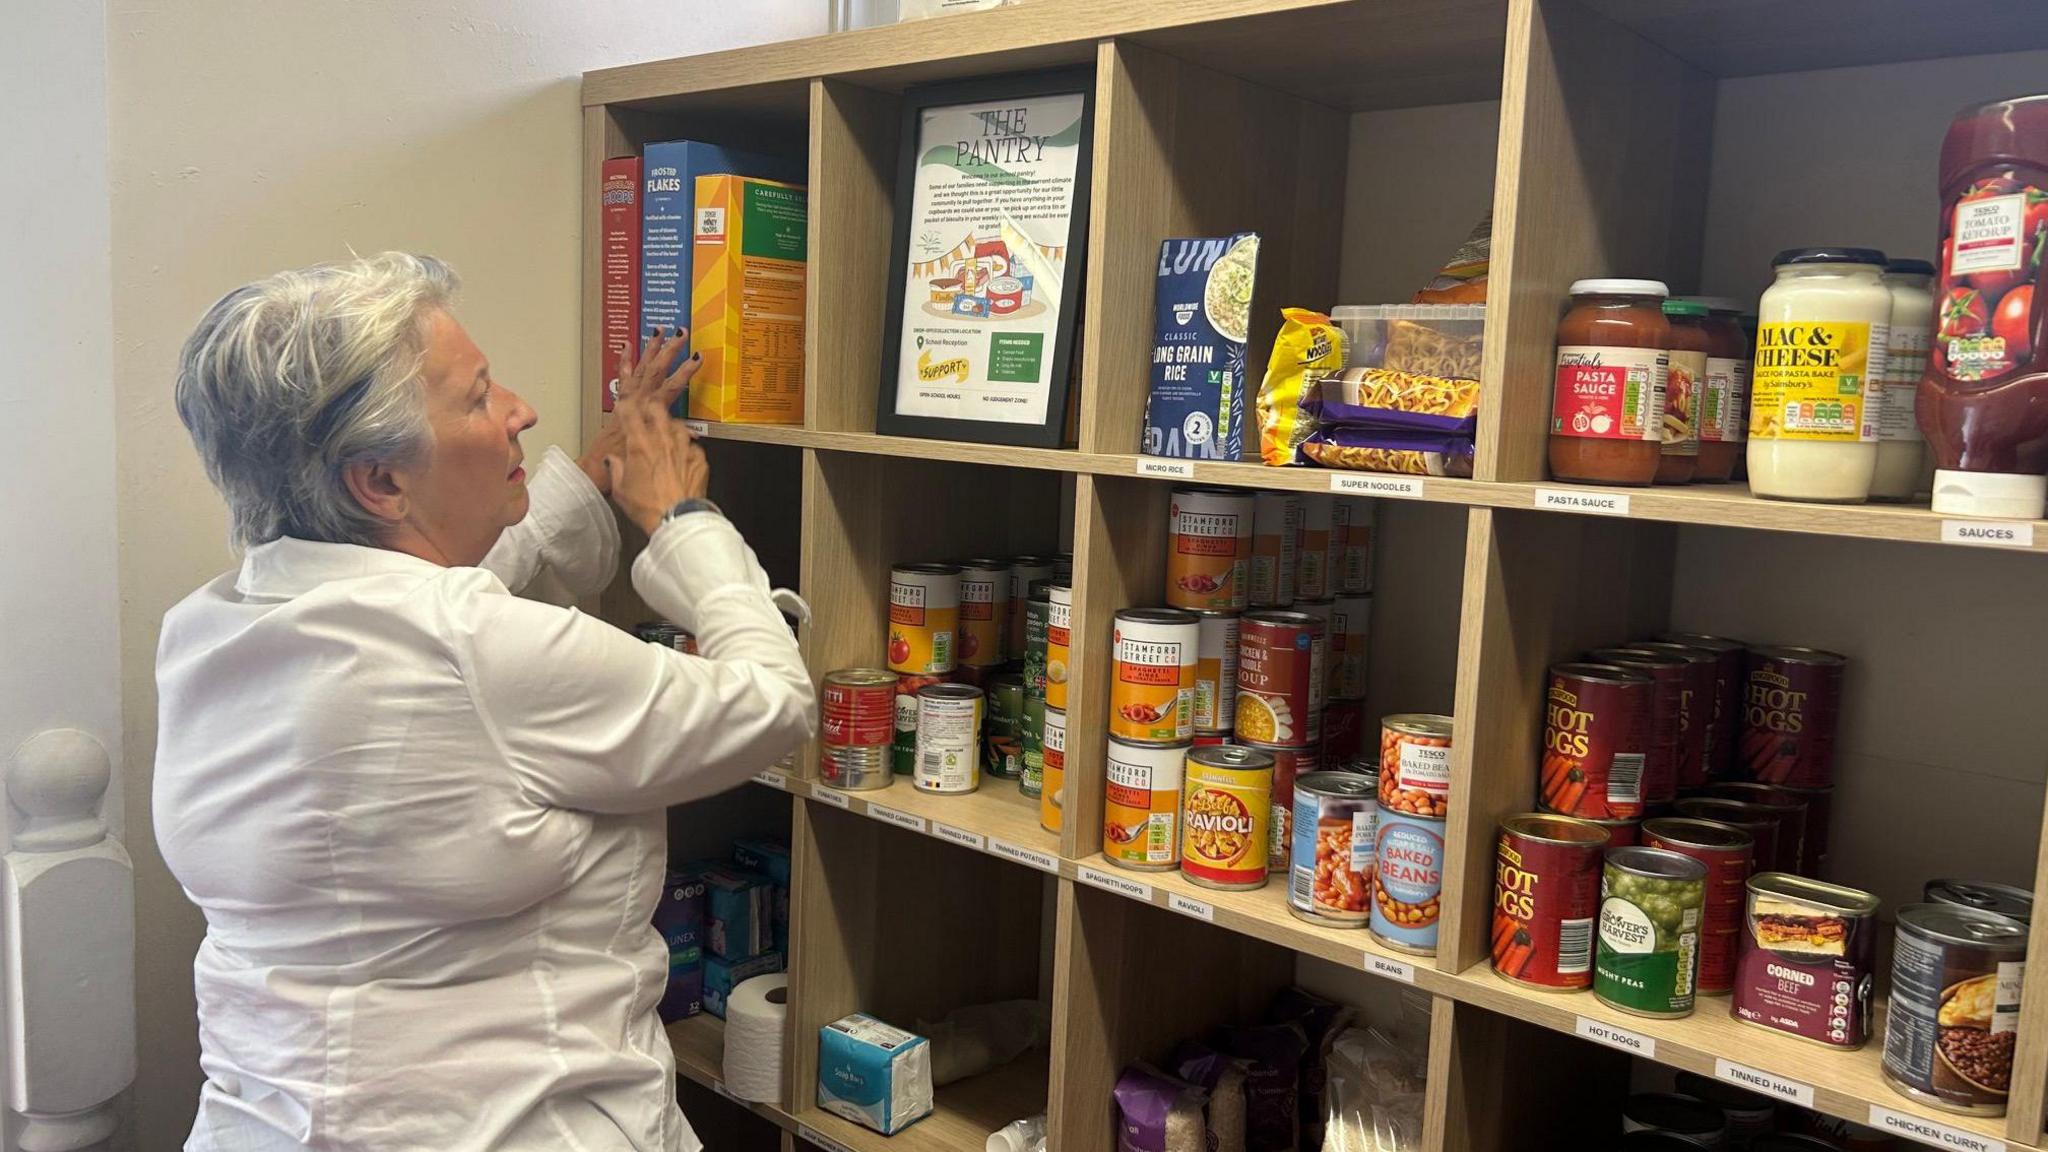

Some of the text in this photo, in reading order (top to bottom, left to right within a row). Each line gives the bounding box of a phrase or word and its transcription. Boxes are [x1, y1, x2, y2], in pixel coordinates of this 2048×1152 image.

[980, 108, 1027, 136] THE
[955, 136, 1050, 166] PANTRY
[651, 167, 677, 177] FROSTED
[648, 178, 680, 192] FLAKES
[754, 188, 792, 200] CAREFULLY
[1974, 205, 2000, 216] TESCO
[1965, 215, 2010, 229] TOMATO
[1962, 226, 2012, 241] KETCHUP
[1164, 332, 1198, 341] CLASSIC
[1761, 326, 1832, 346] MAC &
[1176, 346, 1214, 364] GRAIN
[1756, 348, 1840, 368] CHEESE
[922, 360, 962, 378] SUPPORT
[1164, 365, 1187, 381] RICE
[1576, 371, 1616, 382] PASTA
[1574, 383, 1616, 394] SAUCE
[1769, 380, 1813, 390] Sainsbury's
[1193, 420, 1201, 434] 2
[1146, 464, 1184, 474] MICRO RICE
[1341, 478, 1412, 493] SUPER NOODLES
[1548, 496, 1614, 508] PASTA SAUCE
[1182, 515, 1234, 526] STAMFORD
[1182, 524, 1218, 534] STREET
[1959, 528, 2014, 540] SAUCES
[1124, 642, 1176, 654] STAMFORD
[1262, 650, 1268, 660] &
[1124, 652, 1160, 663] STREET
[1130, 666, 1170, 674] SPAGHETTI
[1752, 684, 1806, 712] HOT
[1548, 702, 1594, 734] HOT
[1749, 704, 1802, 734] OGS
[1418, 750, 1446, 758] TESCO
[1402, 759, 1450, 771] BAKED BEA
[1201, 798, 1232, 814] Beef
[874, 808, 919, 828] TINNED CARROTS
[1186, 810, 1254, 833] RAVIOLI
[938, 827, 962, 840] TINNED
[1393, 831, 1428, 844] REDUCED
[994, 843, 1050, 866] TINNED POTATOES
[1386, 848, 1432, 866] BAKED
[1382, 860, 1440, 884] BEANS
[1086, 872, 1144, 895] SPAGHETTI HOOPS
[1178, 900, 1204, 914] RAVIOLI
[1602, 912, 1648, 935] GROWER'S
[1602, 922, 1646, 944] HARVEST
[1374, 960, 1402, 976] BEANS
[1766, 963, 1815, 986] CORNED
[1621, 976, 1644, 989] PEAS
[1778, 979, 1800, 994] BEEF
[1780, 1016, 1798, 1028] ASDA
[1588, 1026, 1641, 1048] HOT DOGS
[1730, 1068, 1798, 1097] TINNED HAM
[1886, 1116, 1990, 1152] CHICKEN CURRY
